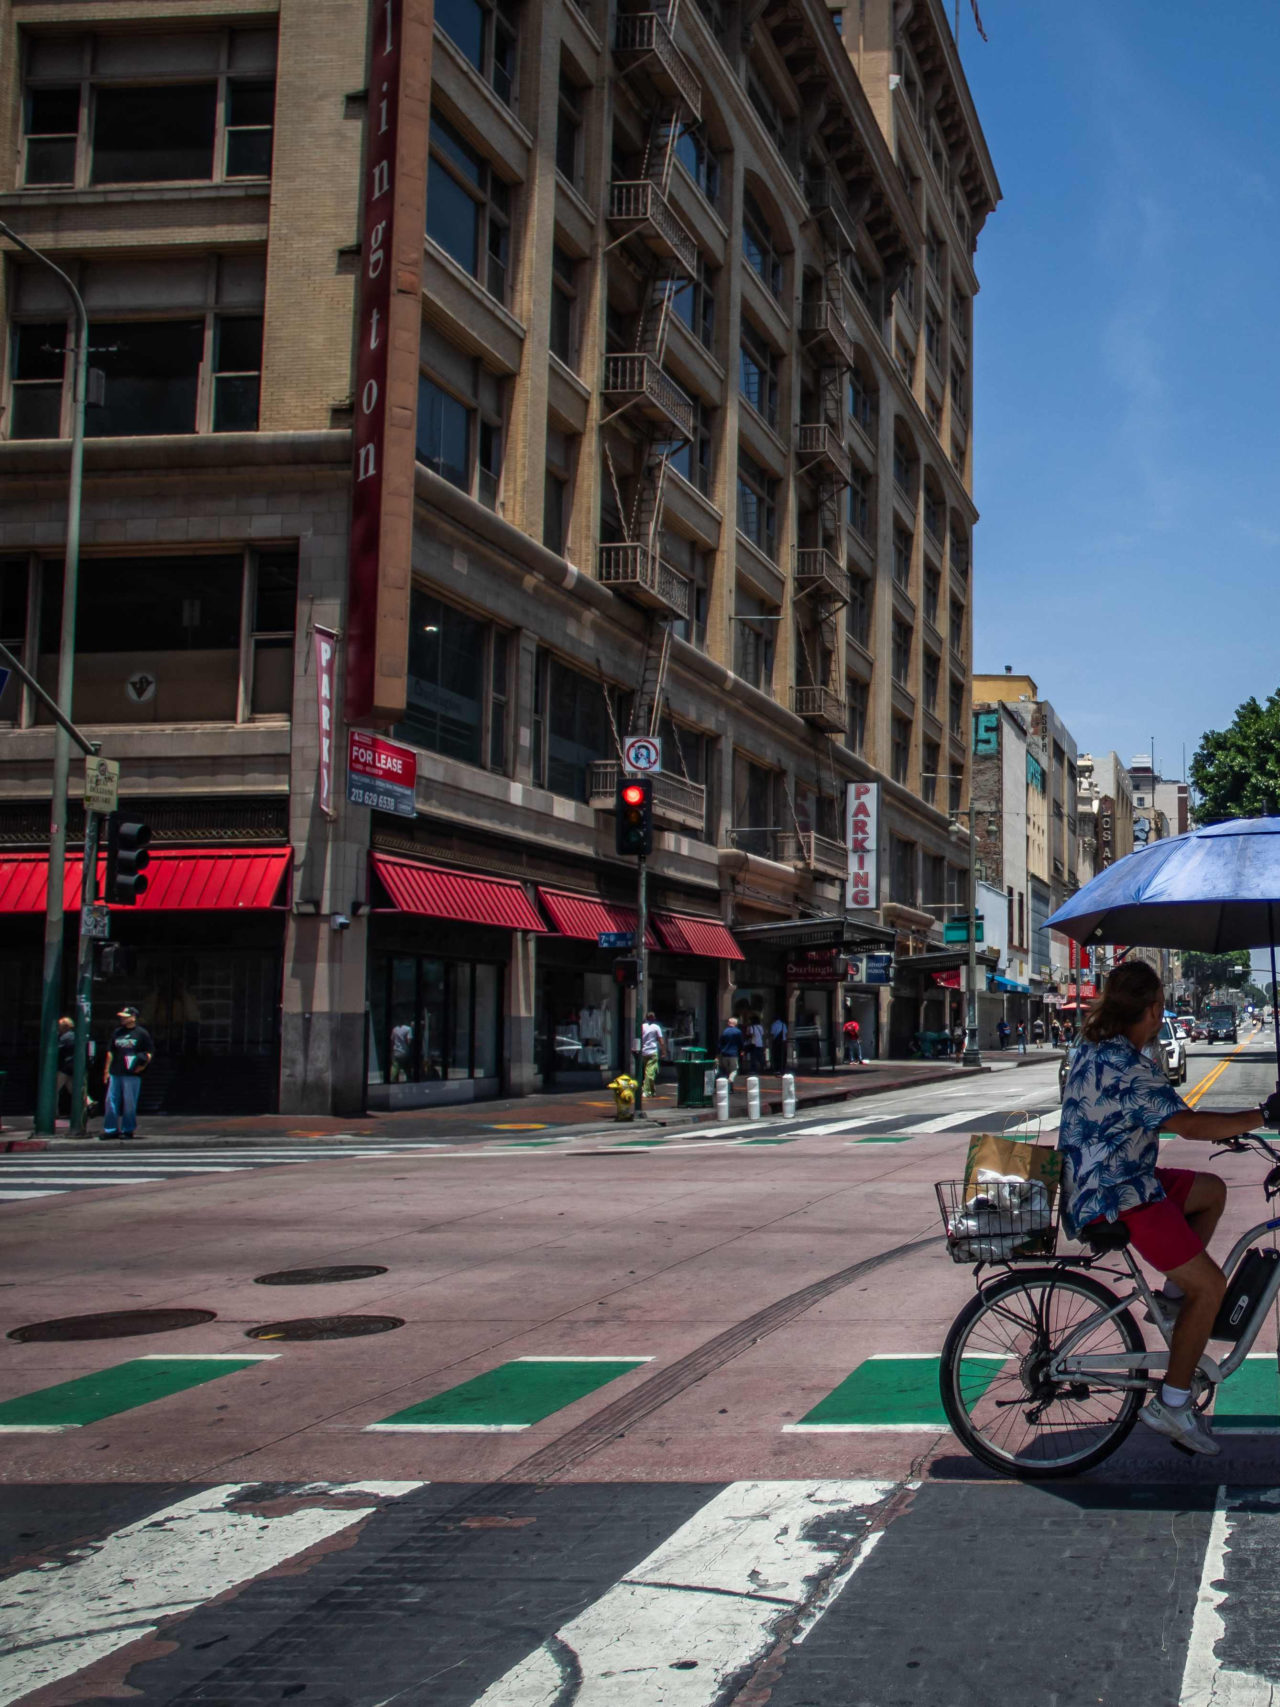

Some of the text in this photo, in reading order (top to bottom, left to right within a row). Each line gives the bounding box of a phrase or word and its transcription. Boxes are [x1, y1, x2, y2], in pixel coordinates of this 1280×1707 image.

[352, 746, 373, 765] FOR
[375, 752, 403, 775] LEASE
[351, 788, 364, 803] 213
[852, 783, 871, 907] PARKING
